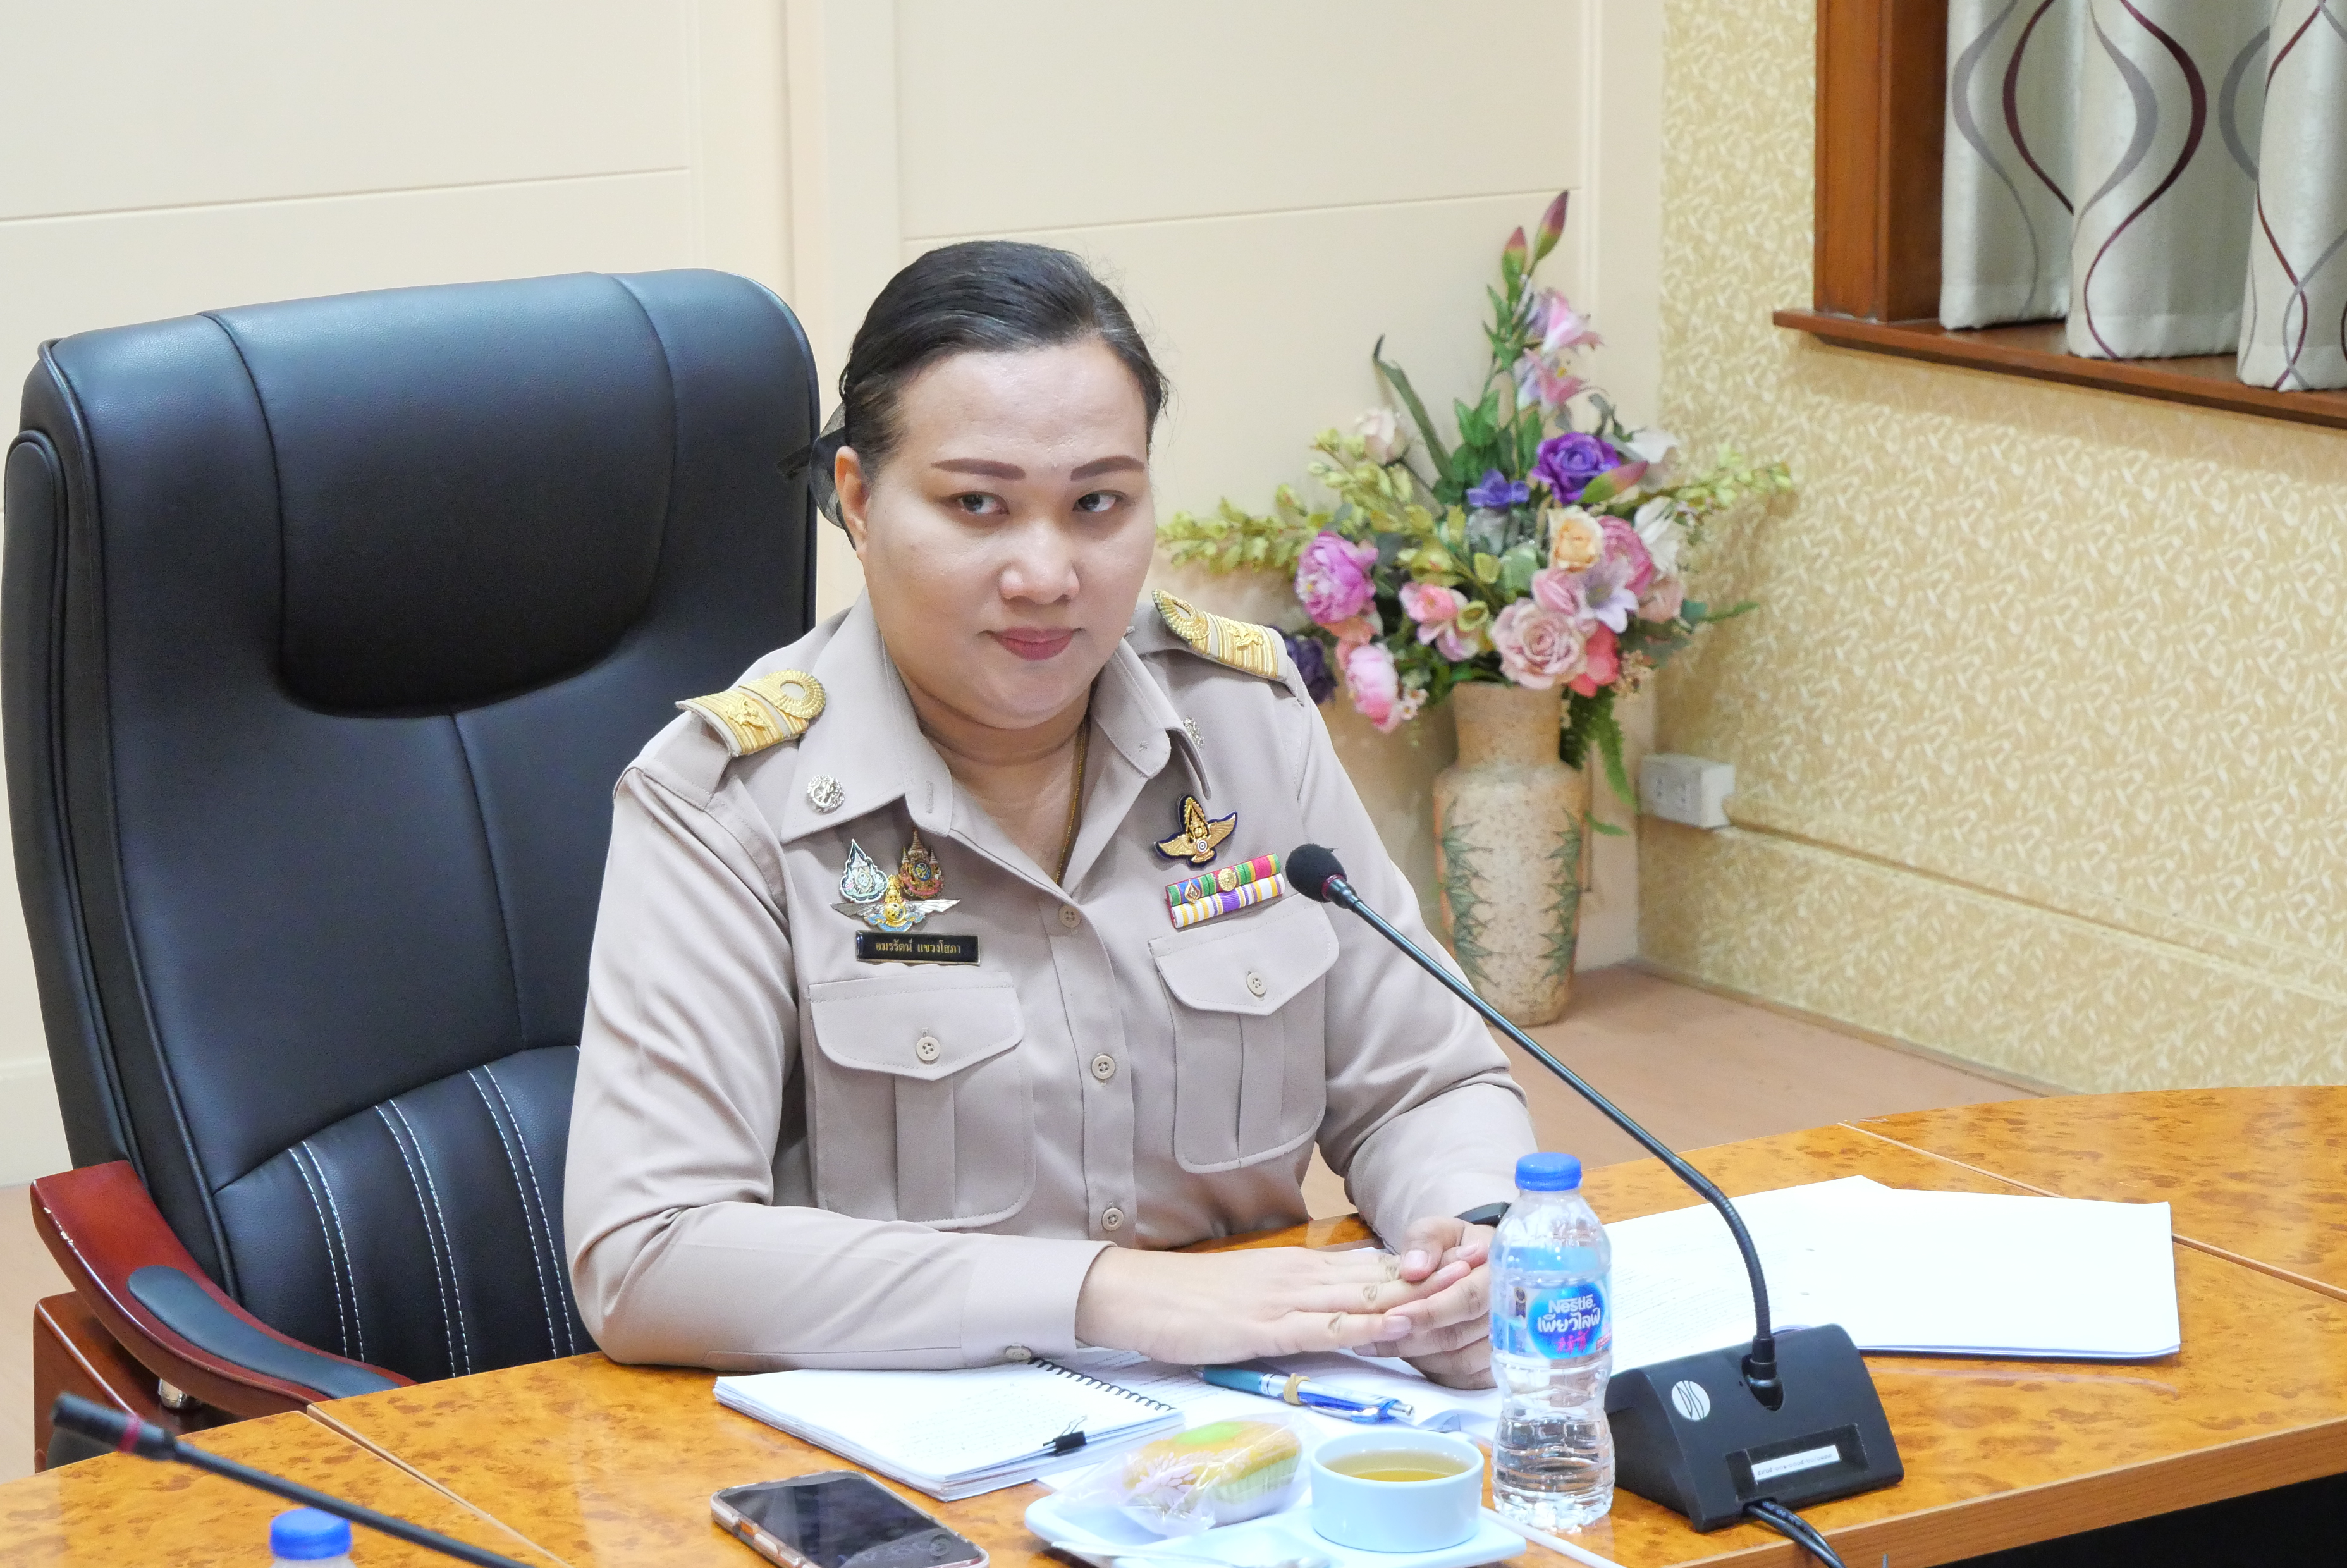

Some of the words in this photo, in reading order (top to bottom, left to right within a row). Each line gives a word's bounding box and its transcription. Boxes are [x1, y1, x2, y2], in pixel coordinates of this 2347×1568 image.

[876, 938, 912, 952] อมรรัตน์
[917, 940, 961, 953] แขวงโสภา
